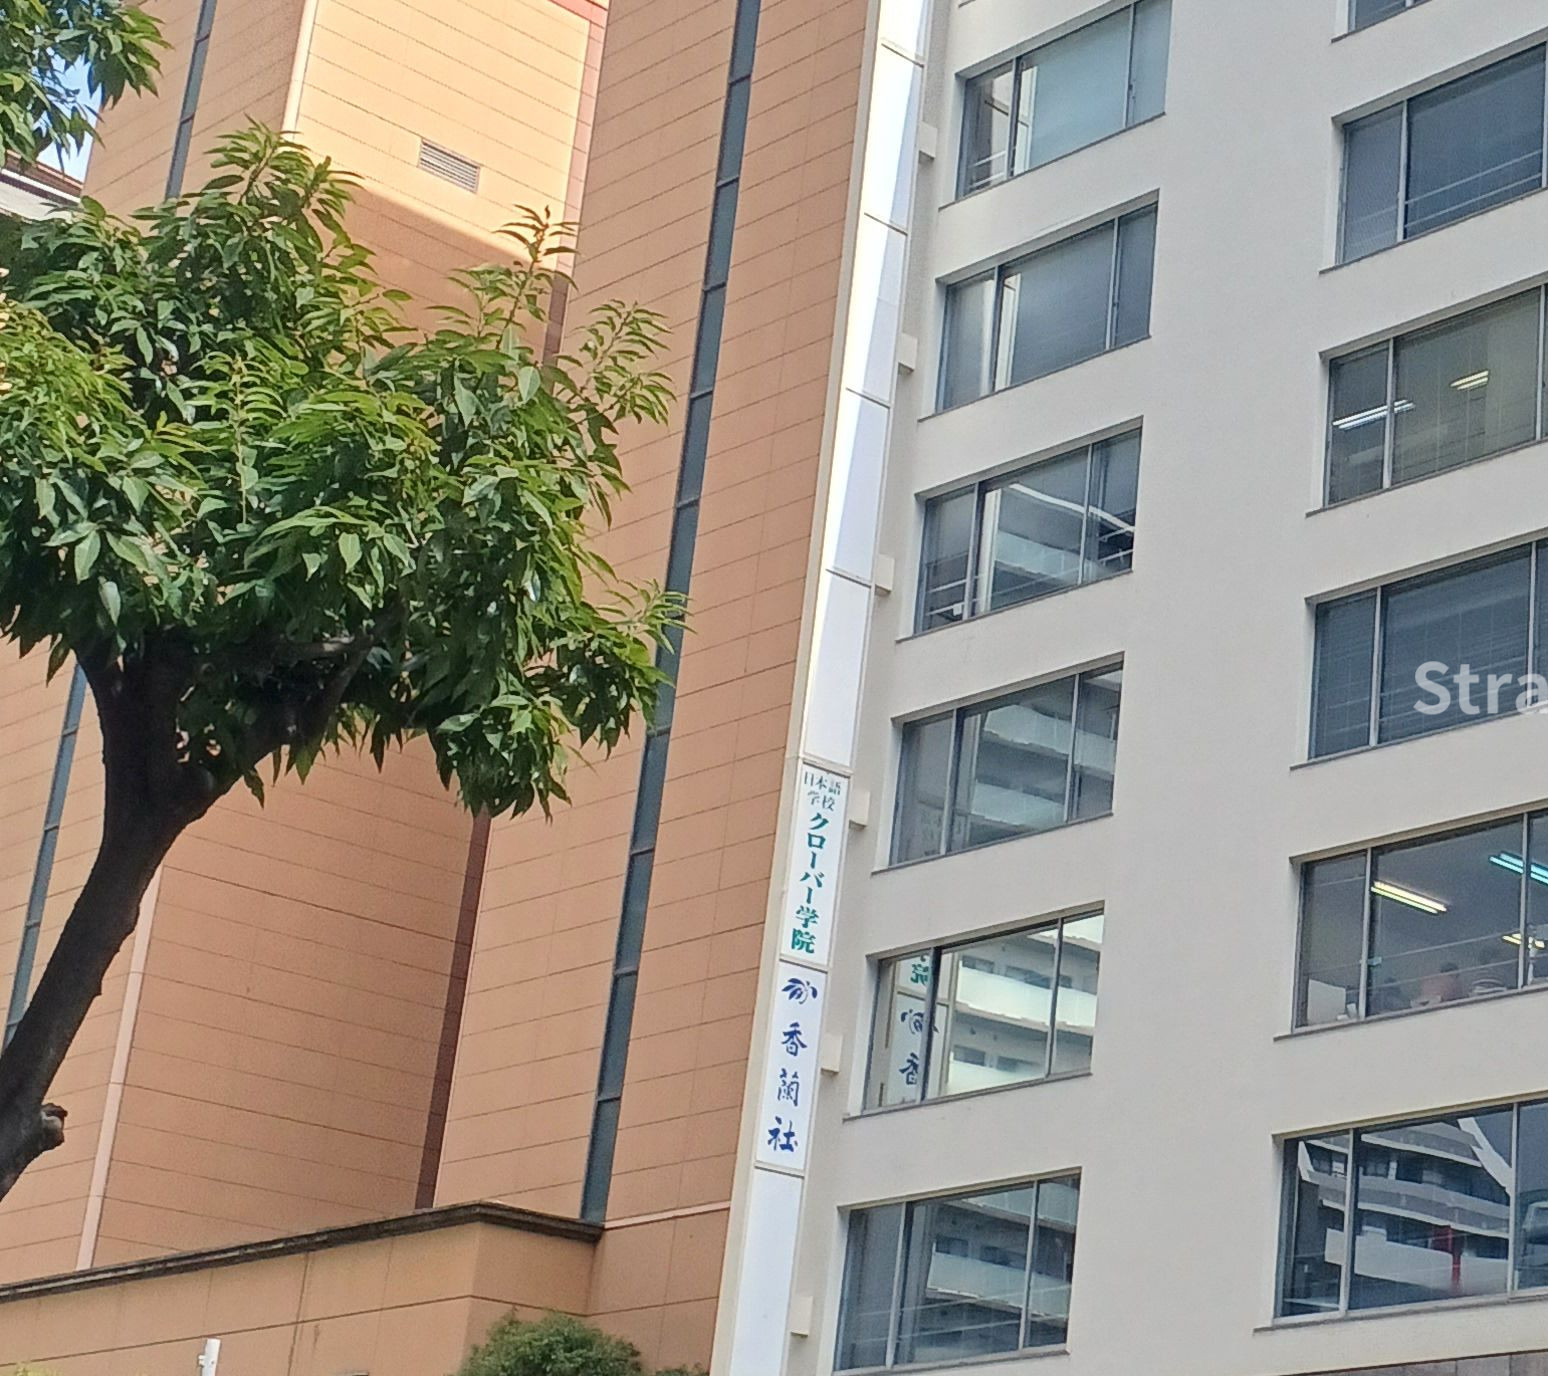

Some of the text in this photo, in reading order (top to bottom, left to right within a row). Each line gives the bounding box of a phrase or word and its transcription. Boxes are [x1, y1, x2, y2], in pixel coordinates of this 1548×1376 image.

[804, 771, 841, 795] 日本語
[807, 790, 835, 812] 学校
[790, 811, 830, 954] クローバー学院
[767, 1022, 808, 1152] 香蘭社
